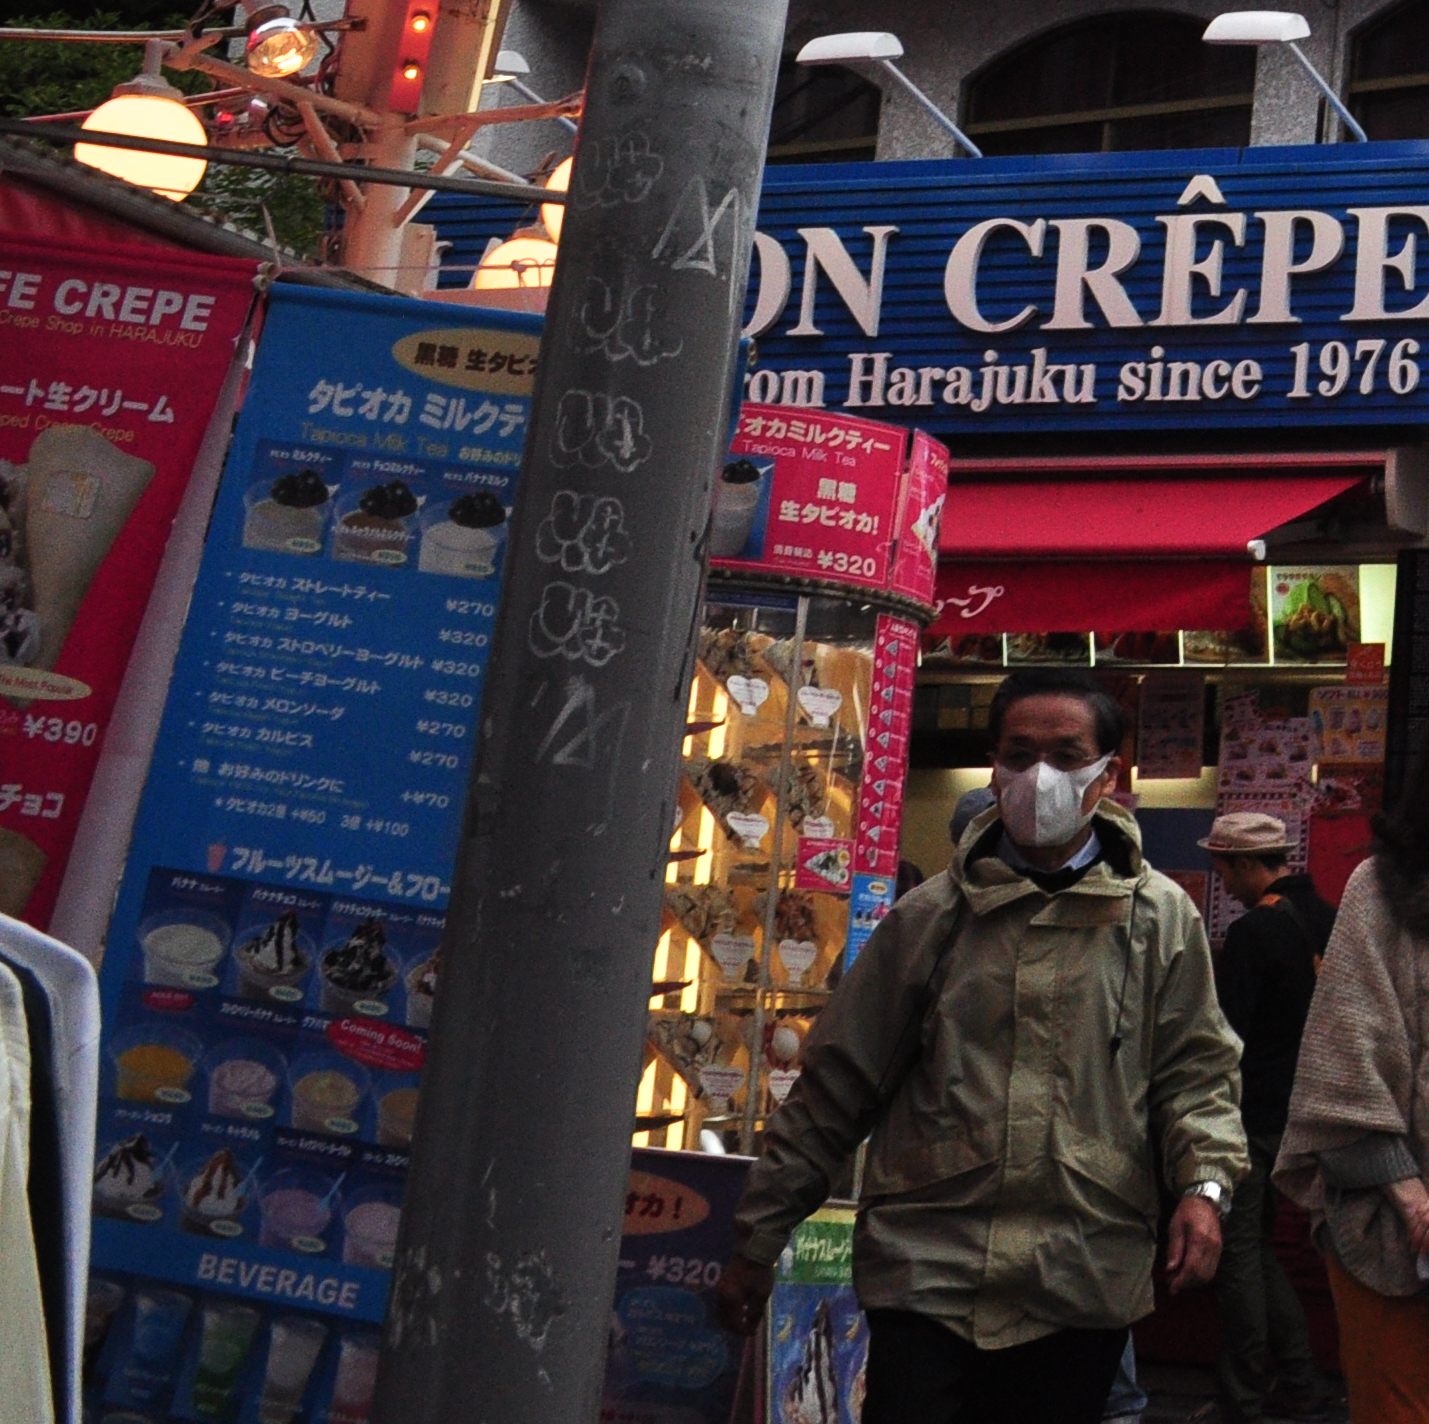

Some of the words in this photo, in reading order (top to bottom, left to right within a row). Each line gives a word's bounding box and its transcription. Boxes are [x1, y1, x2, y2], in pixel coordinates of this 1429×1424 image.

[54, 279, 216, 332] CREPE
[46, 316, 84, 335] Shop
[90, 320, 104, 335] in
[109, 325, 203, 349] HARAJUKU
[414, 342, 460, 370] 黒糖
[844, 351, 1098, 414] Harajuku
[1117, 343, 1266, 404] since
[1285, 338, 1421, 400] 1976
[0, 378, 175, 424] ート生クリーム
[308, 379, 413, 425] タピオカ
[302, 422, 368, 448] Tapioca
[373, 433, 406, 453] Milk
[417, 438, 448, 458] Tea
[734, 414, 892, 454] オカミルクティー
[742, 439, 797, 458] Tapioca
[801, 446, 828, 463] Milk
[834, 451, 857, 467] Tea
[816, 477, 857, 504] 黒糖
[778, 500, 880, 536] 生タピオカ!
[817, 549, 877, 578] ¥320
[444, 598, 495, 618] ¥270
[438, 628, 489, 647] ¥320
[431, 658, 480, 677] ¥320
[423, 689, 473, 708] ¥320
[23, 712, 97, 747] ¥390
[415, 719, 466, 738] ¥270
[409, 750, 459, 769] ¥270
[340, 1018, 386, 1046] Coming
[386, 1031, 423, 1055] Soon!
[197, 1252, 361, 1310] BEVERAGE
[647, 1254, 722, 1286] ¥320
